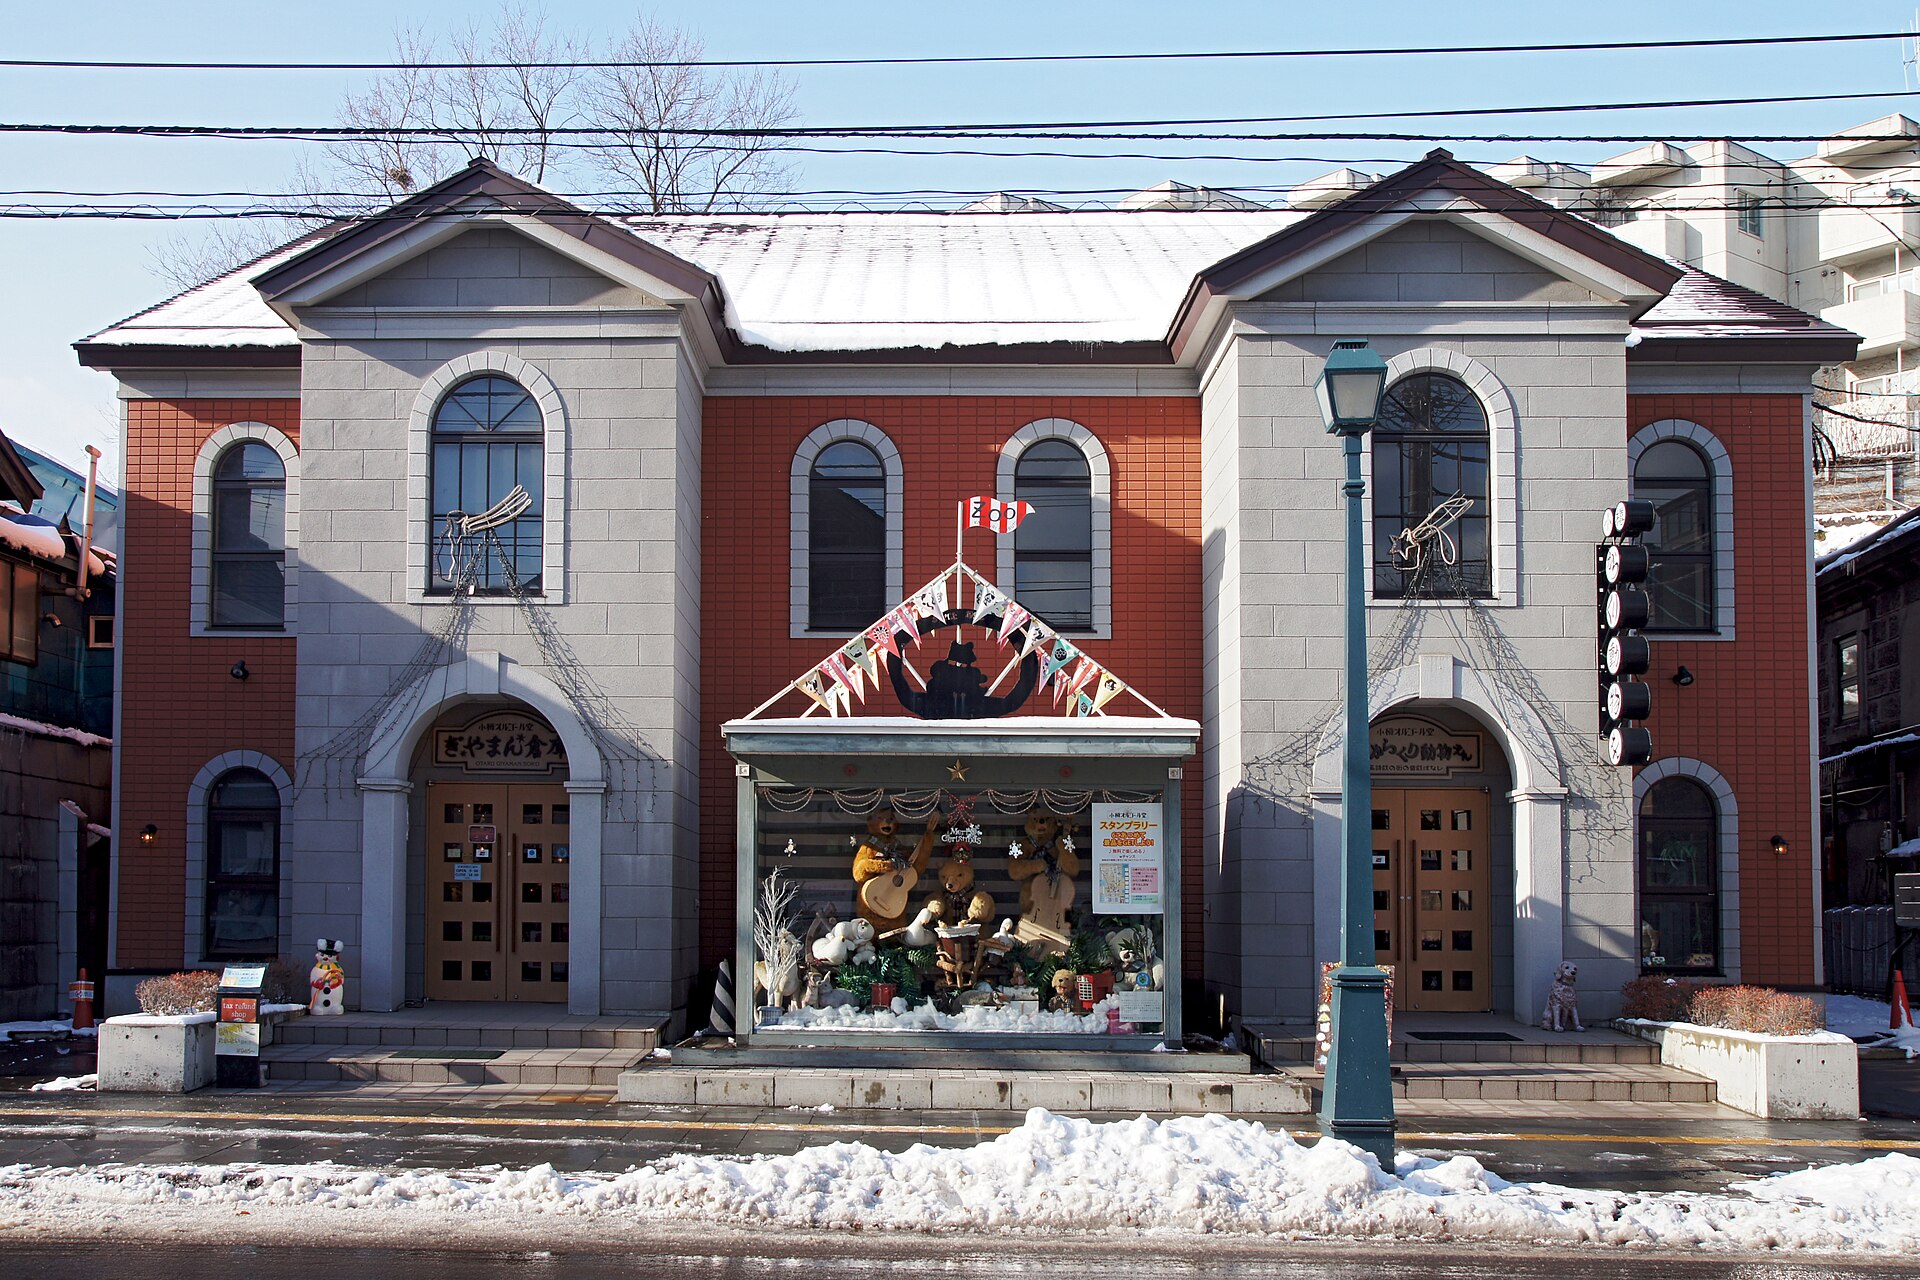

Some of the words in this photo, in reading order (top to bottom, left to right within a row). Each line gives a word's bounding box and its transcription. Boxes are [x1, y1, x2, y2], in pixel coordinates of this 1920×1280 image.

[972, 501, 1016, 521] ZOO
[1099, 821, 1158, 830] スタンプラリー
[235, 1002, 256, 1010] refund
[231, 1010, 247, 1019] shop
